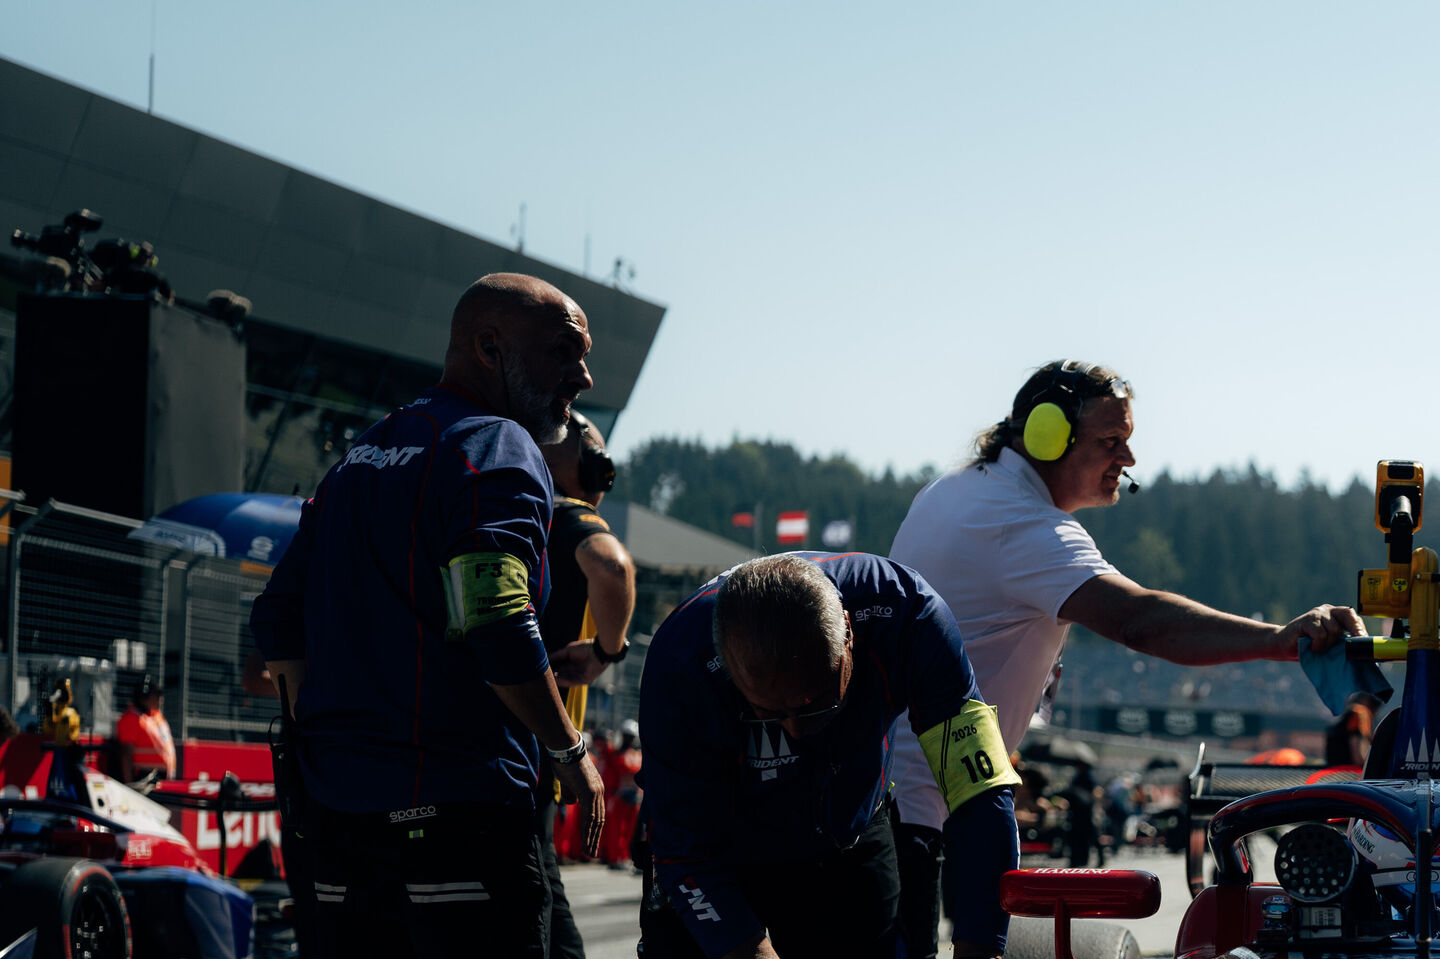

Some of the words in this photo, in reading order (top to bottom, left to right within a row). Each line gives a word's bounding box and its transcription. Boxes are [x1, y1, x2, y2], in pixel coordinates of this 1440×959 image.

[475, 563, 502, 579] F3
[952, 724, 978, 743] 2026
[961, 750, 994, 784] 10
[389, 805, 437, 822] sparco
